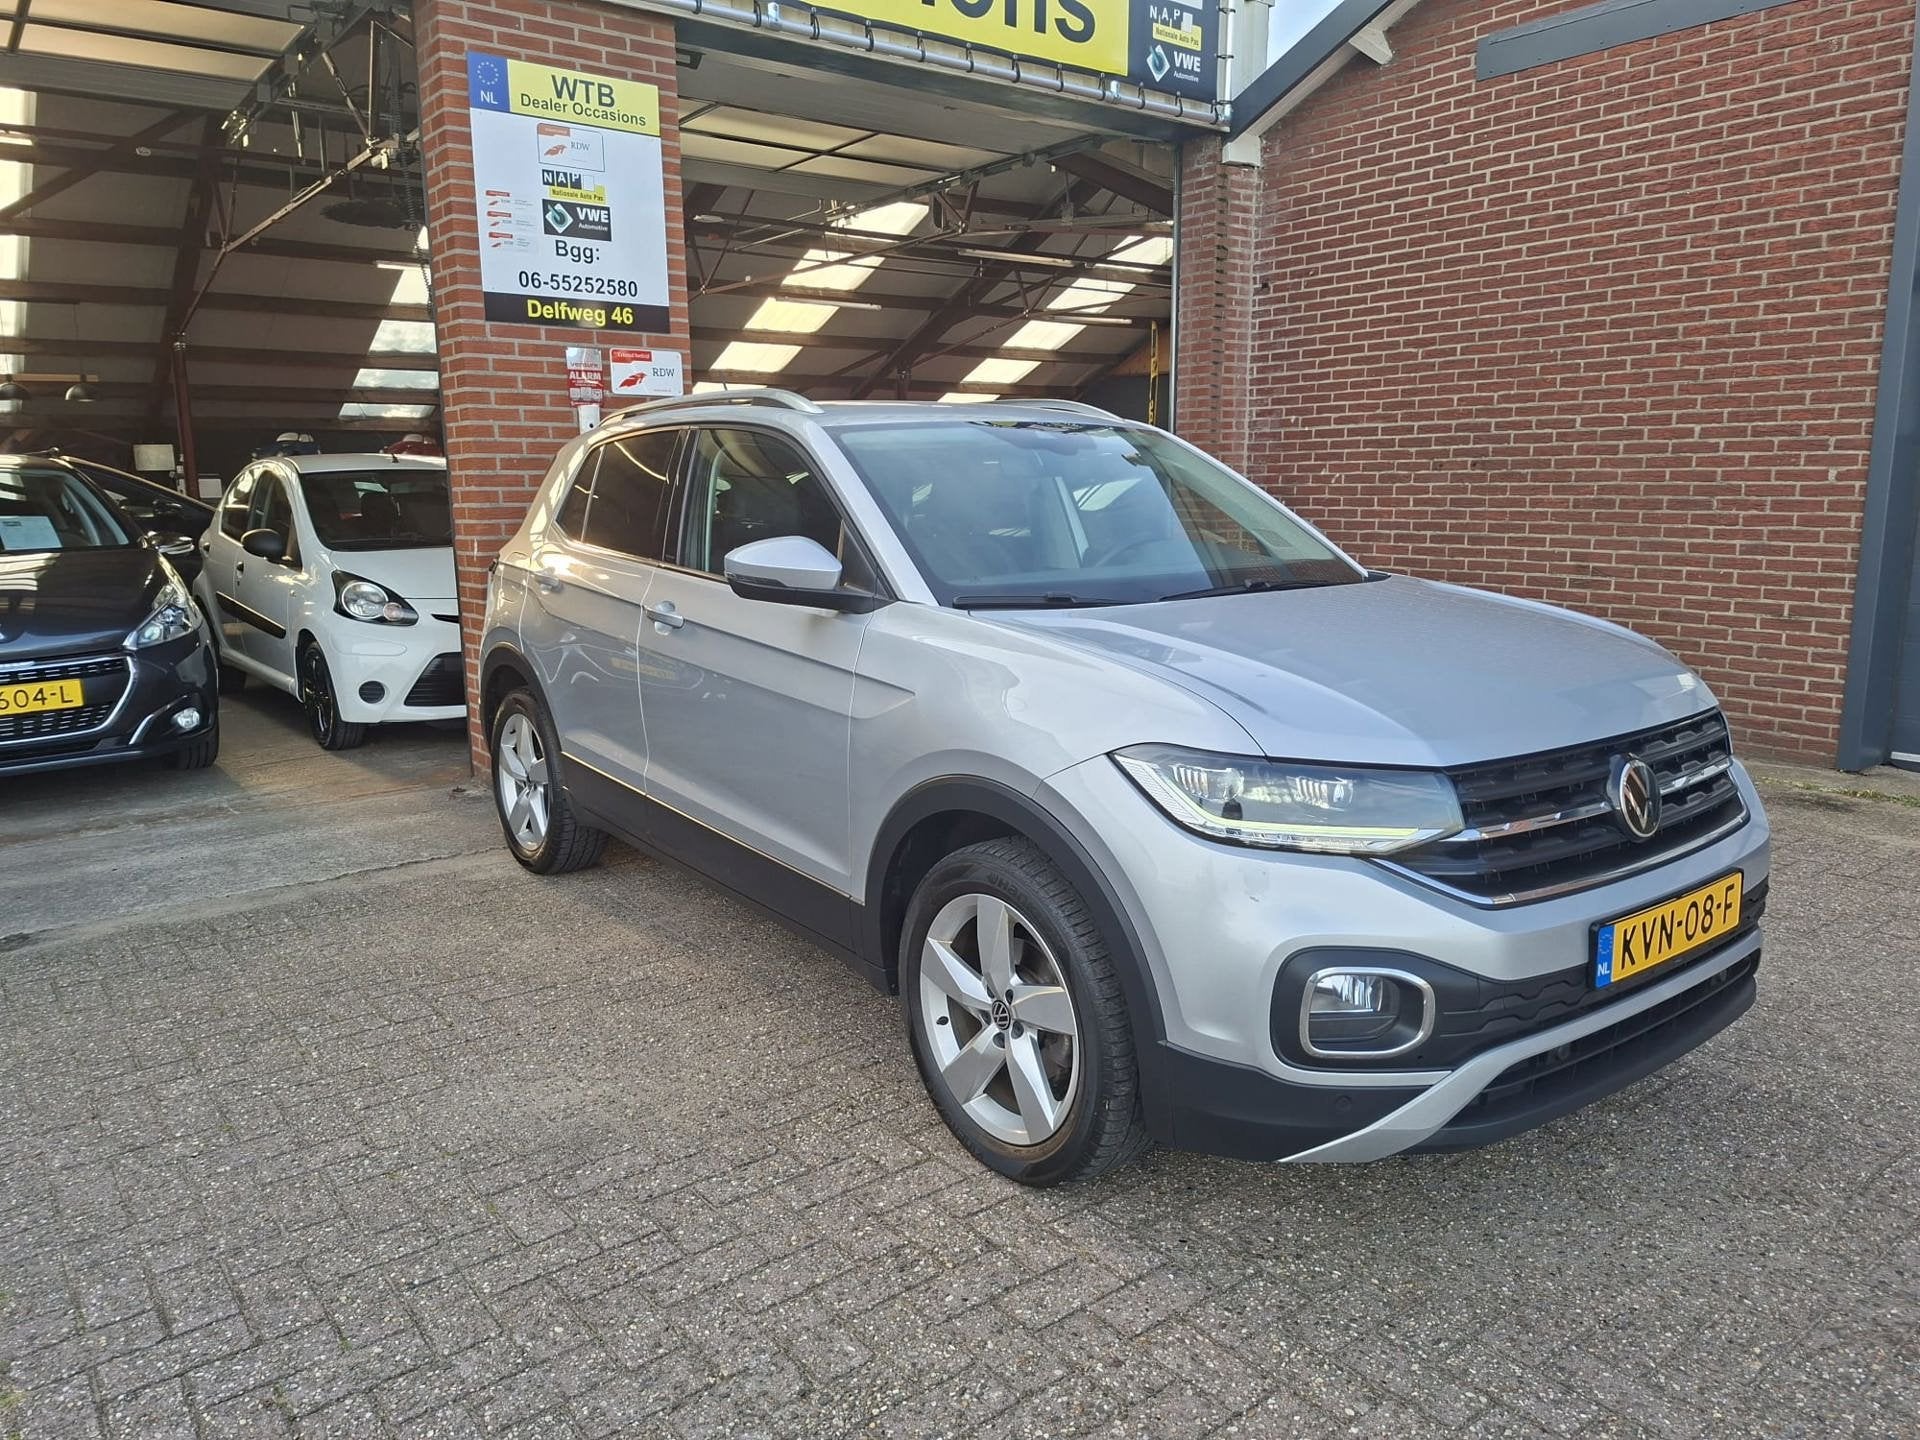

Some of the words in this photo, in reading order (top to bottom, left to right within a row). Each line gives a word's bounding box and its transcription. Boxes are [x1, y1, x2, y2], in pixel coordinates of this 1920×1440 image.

[1155, 27, 1178, 41] Nationale
[1179, 33, 1190, 44] Auto
[1173, 50, 1201, 72] VWE
[1173, 70, 1199, 83] Automotive
[480, 90, 498, 105] NL
[551, 74, 615, 108] WTB
[520, 93, 567, 113] Dealer
[572, 102, 646, 127] Occasions
[570, 141, 591, 151] RDW
[551, 188, 579, 198] Nationale
[580, 192, 592, 200] Auto
[576, 207, 609, 223] VWE
[578, 222, 608, 232] Automotive
[555, 239, 600, 264] Bgg:
[518, 270, 638, 297] 06-55252580
[527, 299, 606, 327] Delfweg
[611, 307, 633, 325] 46
[569, 371, 602, 381] ALARM
[652, 367, 675, 377] RDW
[1621, 883, 1735, 970] KVN-08-F
[1597, 963, 1610, 977] NL
